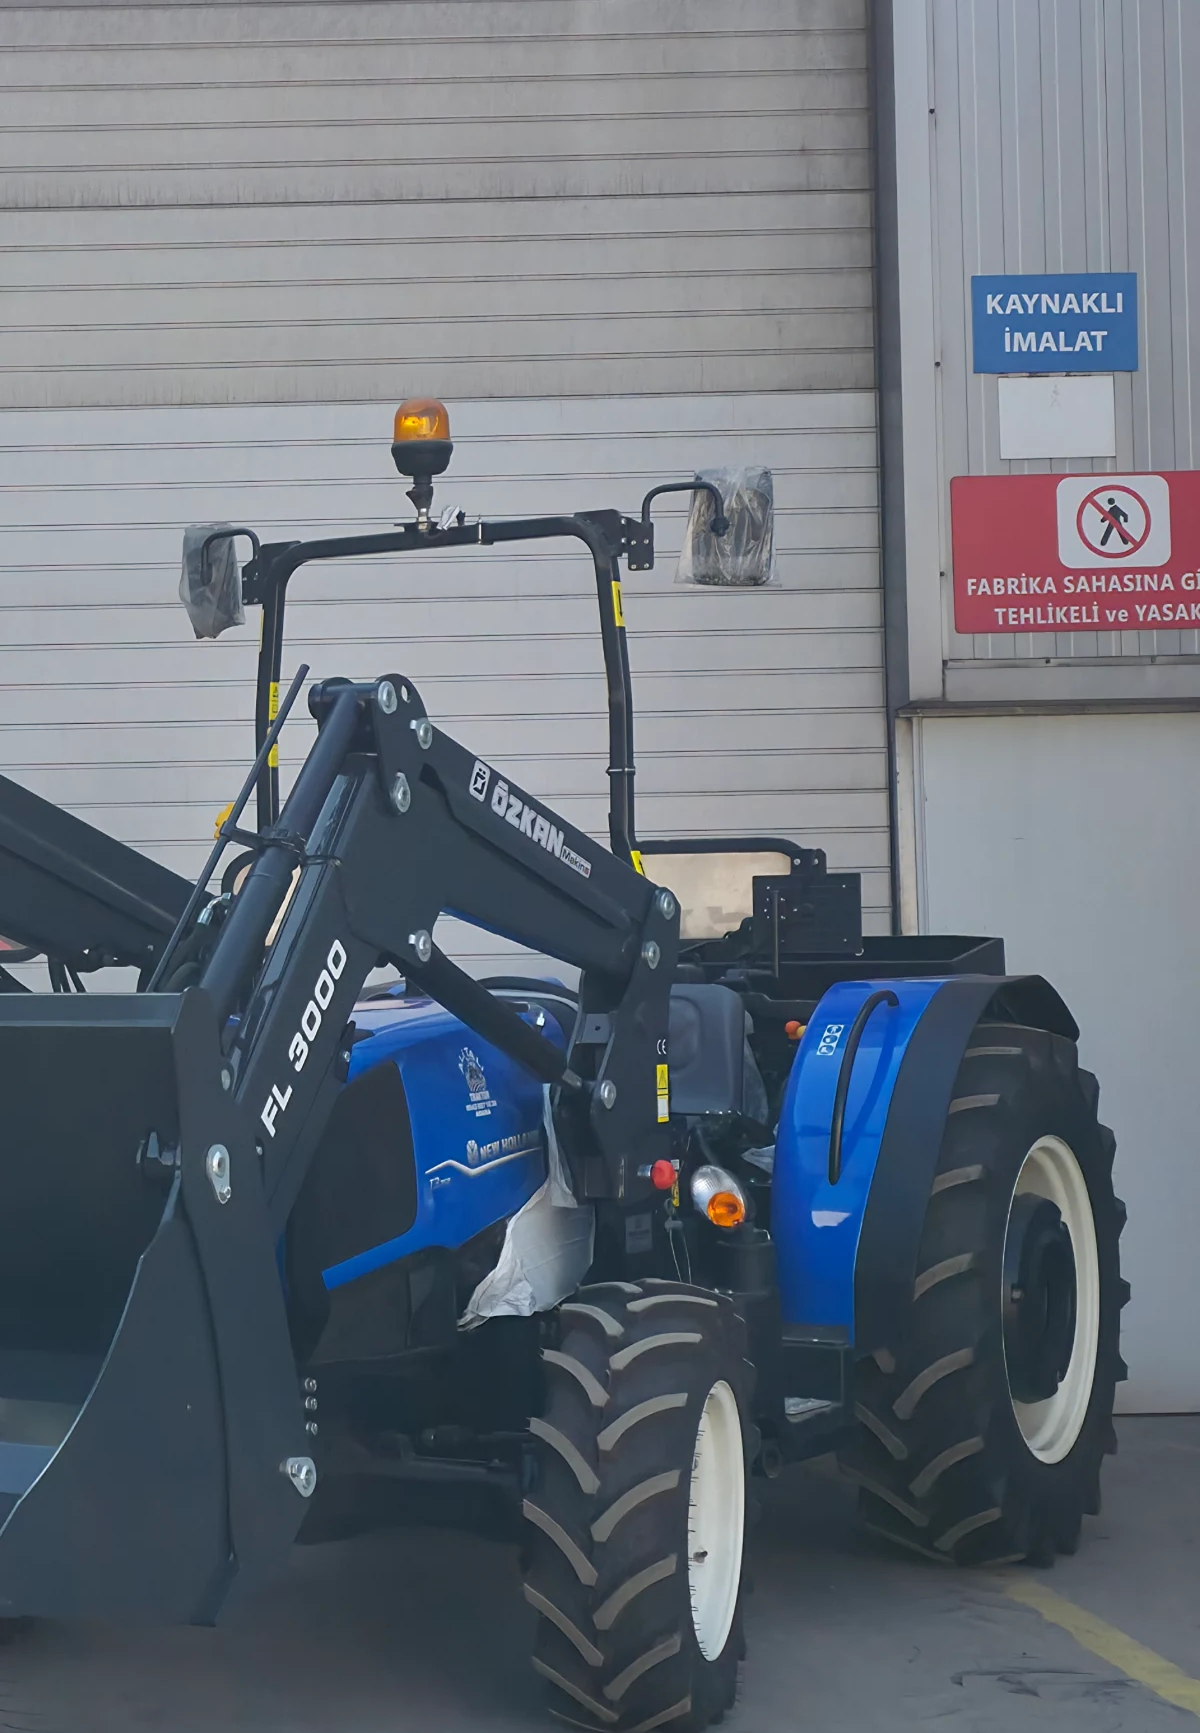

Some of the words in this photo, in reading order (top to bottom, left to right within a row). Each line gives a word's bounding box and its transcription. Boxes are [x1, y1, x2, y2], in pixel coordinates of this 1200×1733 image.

[986, 292, 1123, 315] KAYNAKLI
[1004, 326, 1108, 353] İMALAT
[967, 573, 1058, 596] FABRİKA
[1063, 574, 1175, 594] SAHASINA
[993, 601, 1100, 625] TEHLİKELİ
[1105, 608, 1129, 623] ve
[490, 779, 565, 859] ÖZKAN
[260, 1083, 293, 1138] FL
[288, 939, 347, 1073] 3000
[480, 1140, 500, 1162] NEW
